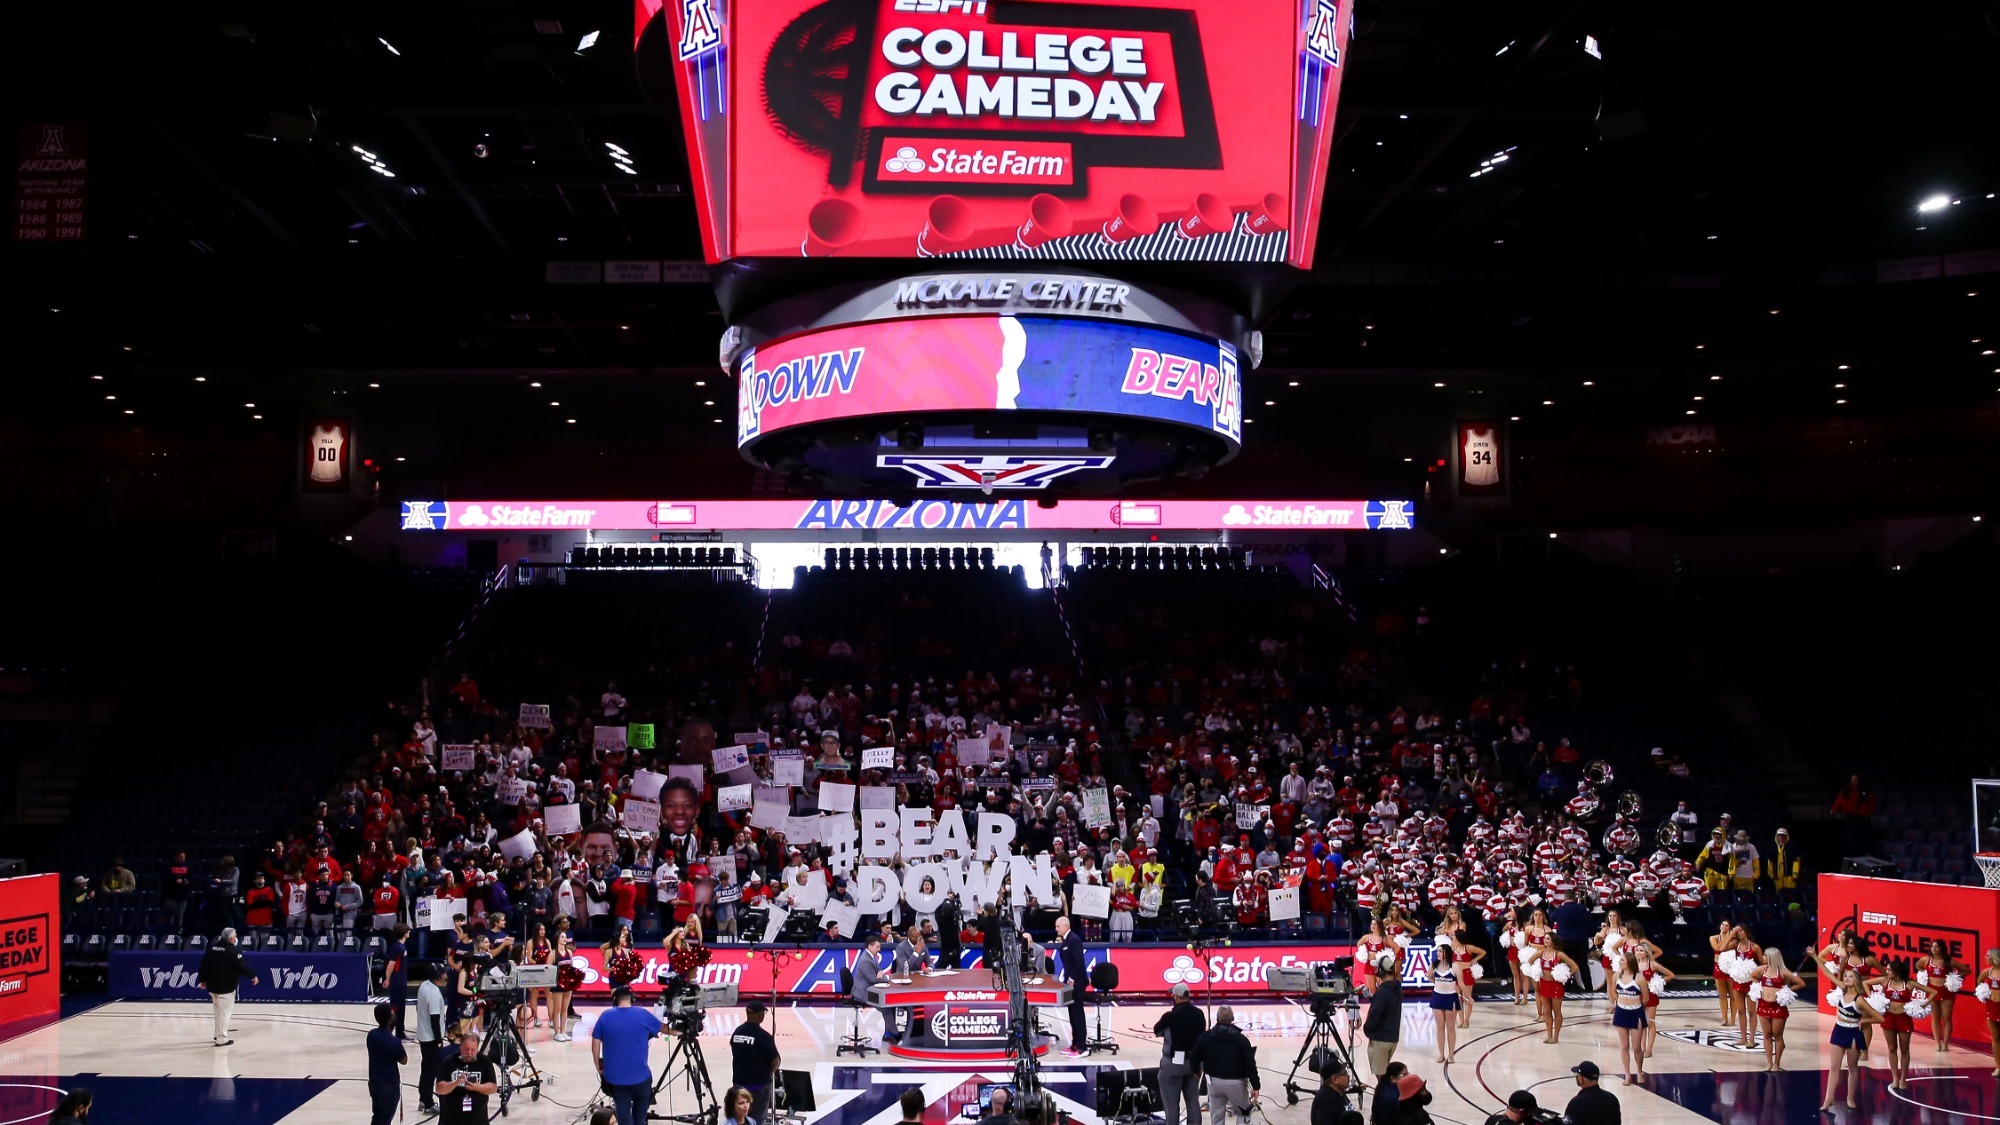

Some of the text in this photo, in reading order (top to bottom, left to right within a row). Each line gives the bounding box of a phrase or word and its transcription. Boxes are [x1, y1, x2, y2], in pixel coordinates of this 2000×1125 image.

[882, 27, 1147, 76] COLLEGE
[875, 71, 1164, 122] GAMEDAY
[17, 159, 87, 173] ARIZONA
[18, 198, 84, 210] 1984 1987
[18, 212, 84, 224] 1988 1989
[18, 226, 83, 240] 1990 1991
[893, 279, 1131, 306] MCKALE CENTER
[755, 347, 865, 411] DOWN
[1120, 347, 1220, 408] BEAR
[1645, 424, 1717, 446] NCAA
[318, 447, 336, 461] 00
[1472, 450, 1491, 465] 34
[794, 500, 1029, 529] ARIZONA
[522, 705, 549, 715] ZERO
[595, 740, 626, 749] TUCSON
[627, 803, 639, 812] IN
[1237, 812, 1255, 820] BALL
[861, 808, 1016, 861] BEAR
[858, 855, 1052, 915] DOWN
[295, 895, 304, 903] 20
[1862, 911, 1897, 926] ESPN
[1864, 930, 1963, 958] COLLEE
[270, 965, 338, 989] Vrbo
[949, 1015, 998, 1025] COLLEGE
[950, 1025, 1001, 1035] GAMEDAY
[733, 1035, 755, 1045] ESPN
